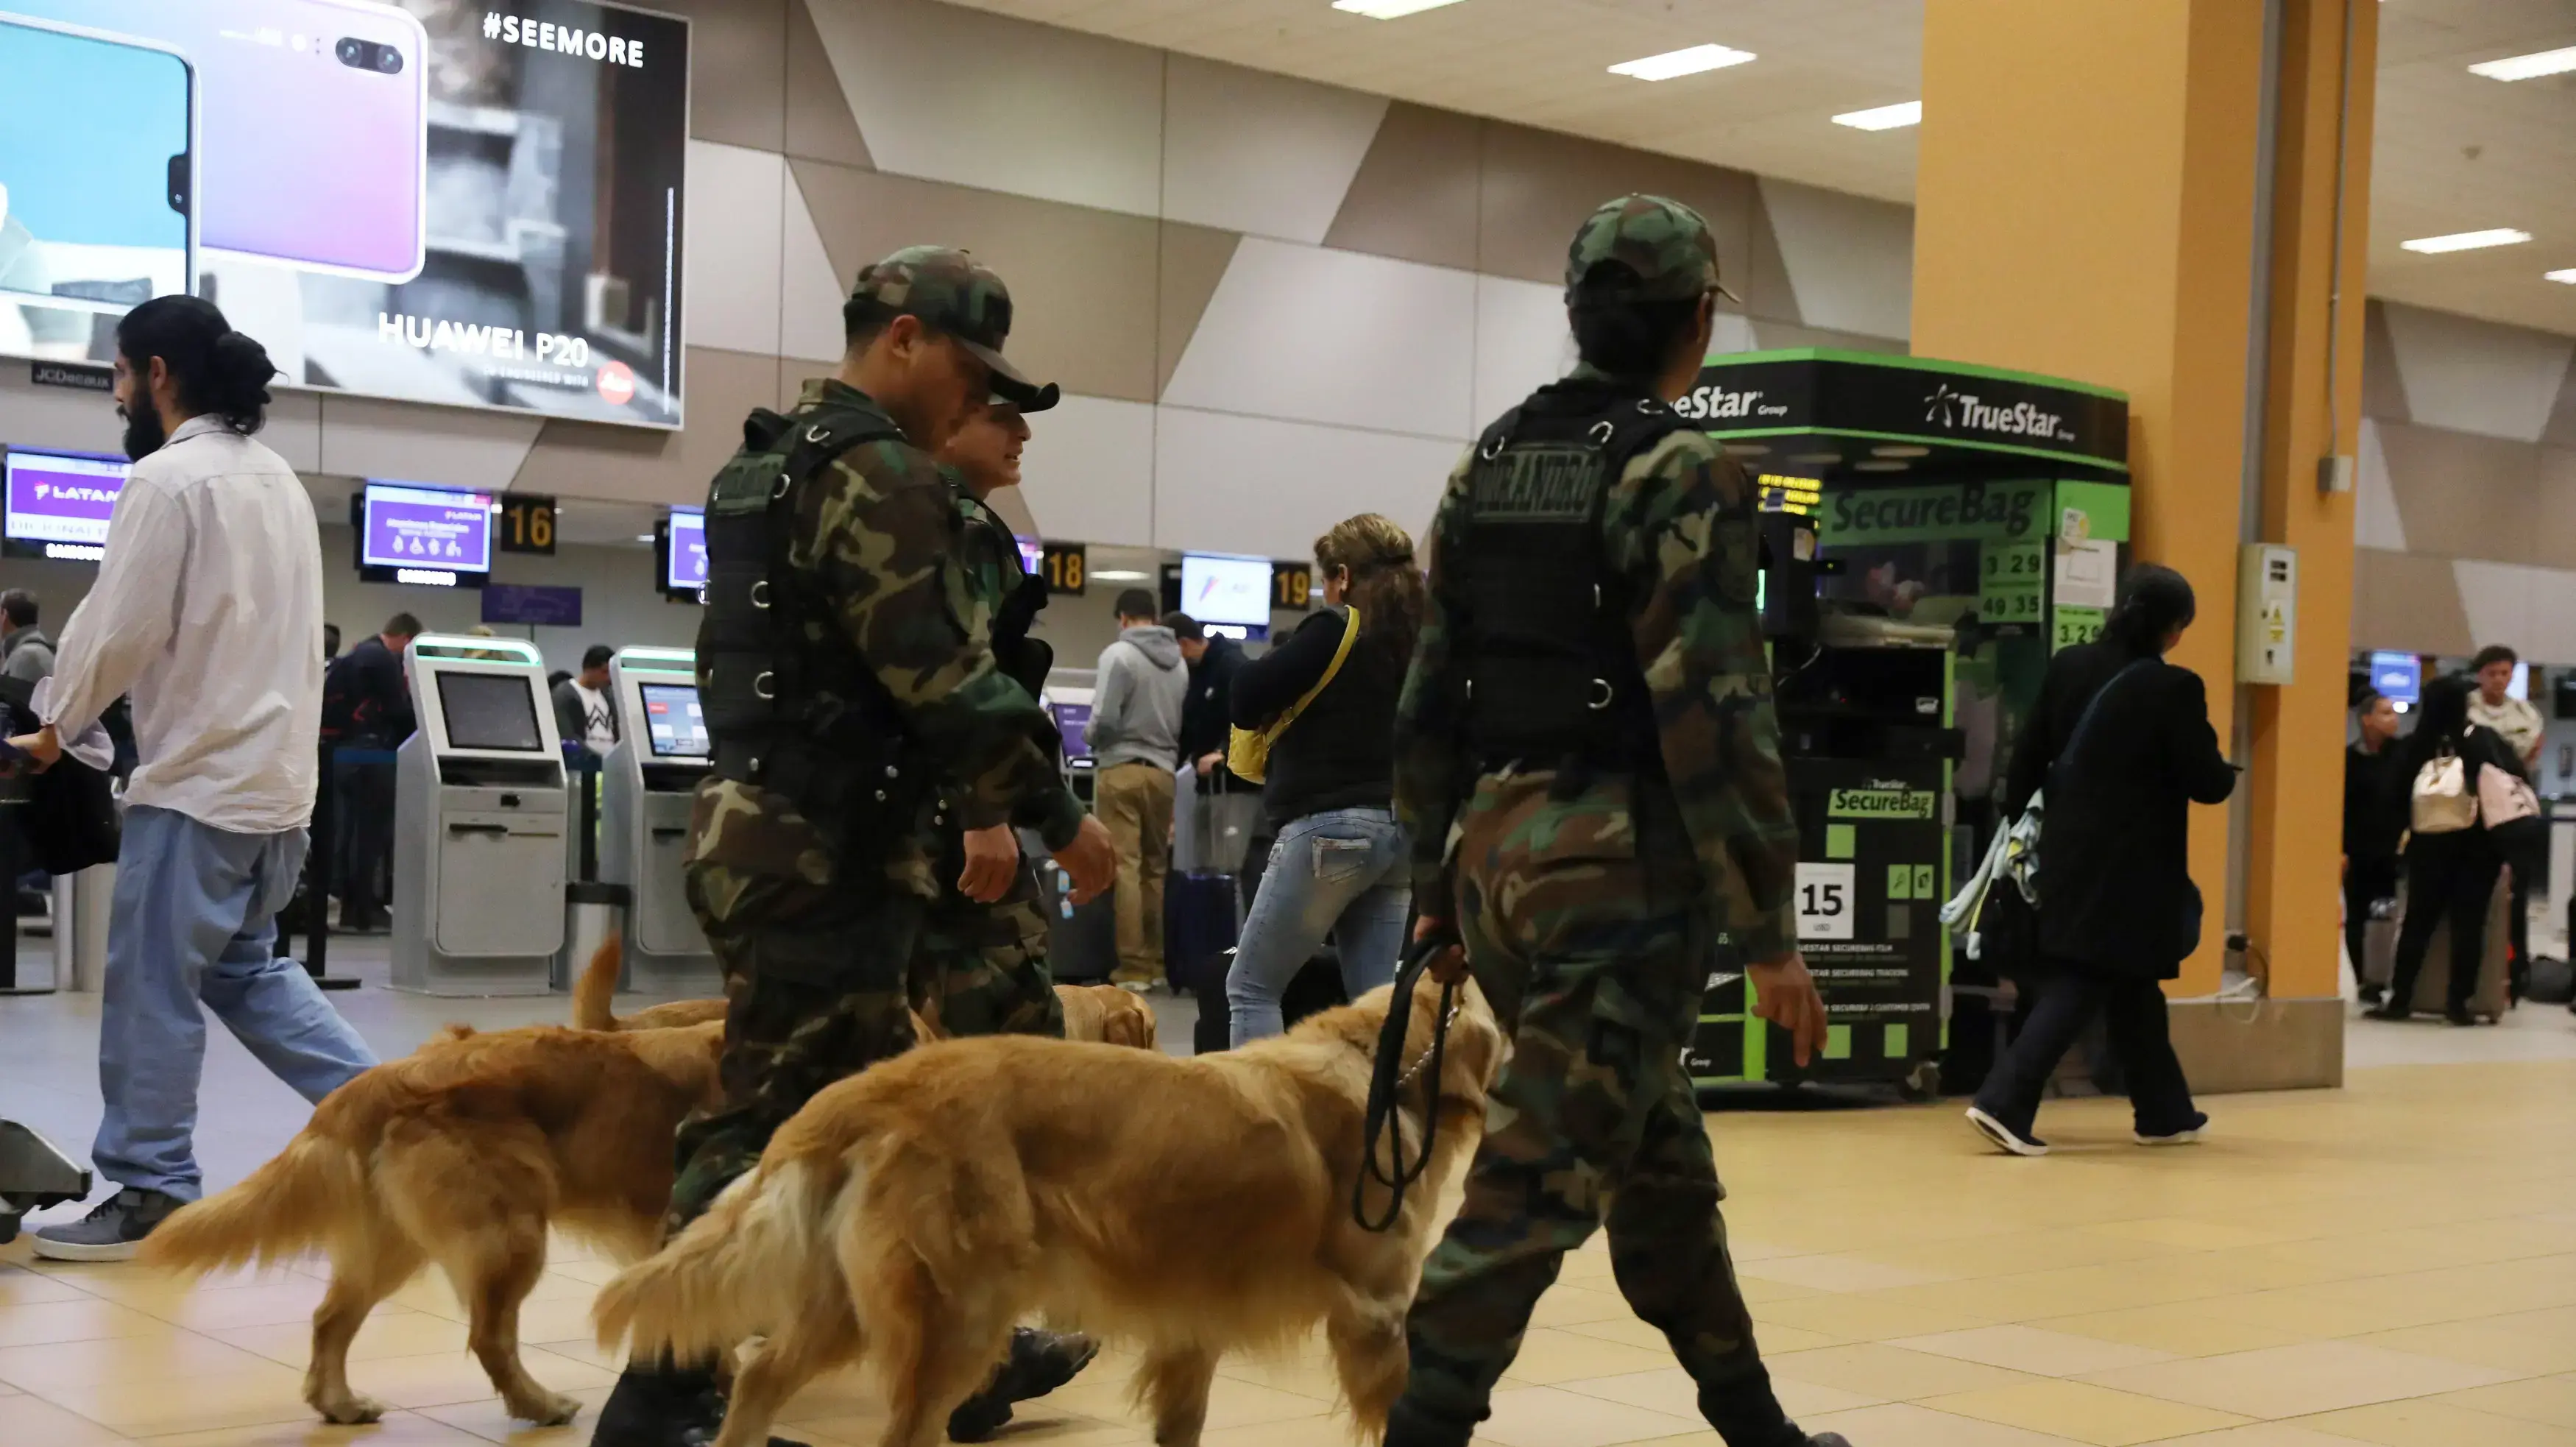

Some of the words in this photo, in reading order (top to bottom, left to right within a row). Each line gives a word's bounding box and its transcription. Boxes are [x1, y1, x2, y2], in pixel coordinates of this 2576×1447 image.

[483, 11, 644, 68] #SEEMORE
[378, 312, 524, 360] HUAWEI
[536, 333, 589, 367] P20
[1670, 386, 1757, 419] eStar
[1959, 395, 2060, 437] TrueStar
[509, 504, 551, 546] 16
[1832, 482, 2036, 537] SecureBag
[1050, 553, 1082, 589] 18
[1278, 571, 1309, 604] 19
[1836, 790, 1928, 818] SecureBag
[1802, 884, 1843, 916] 15
